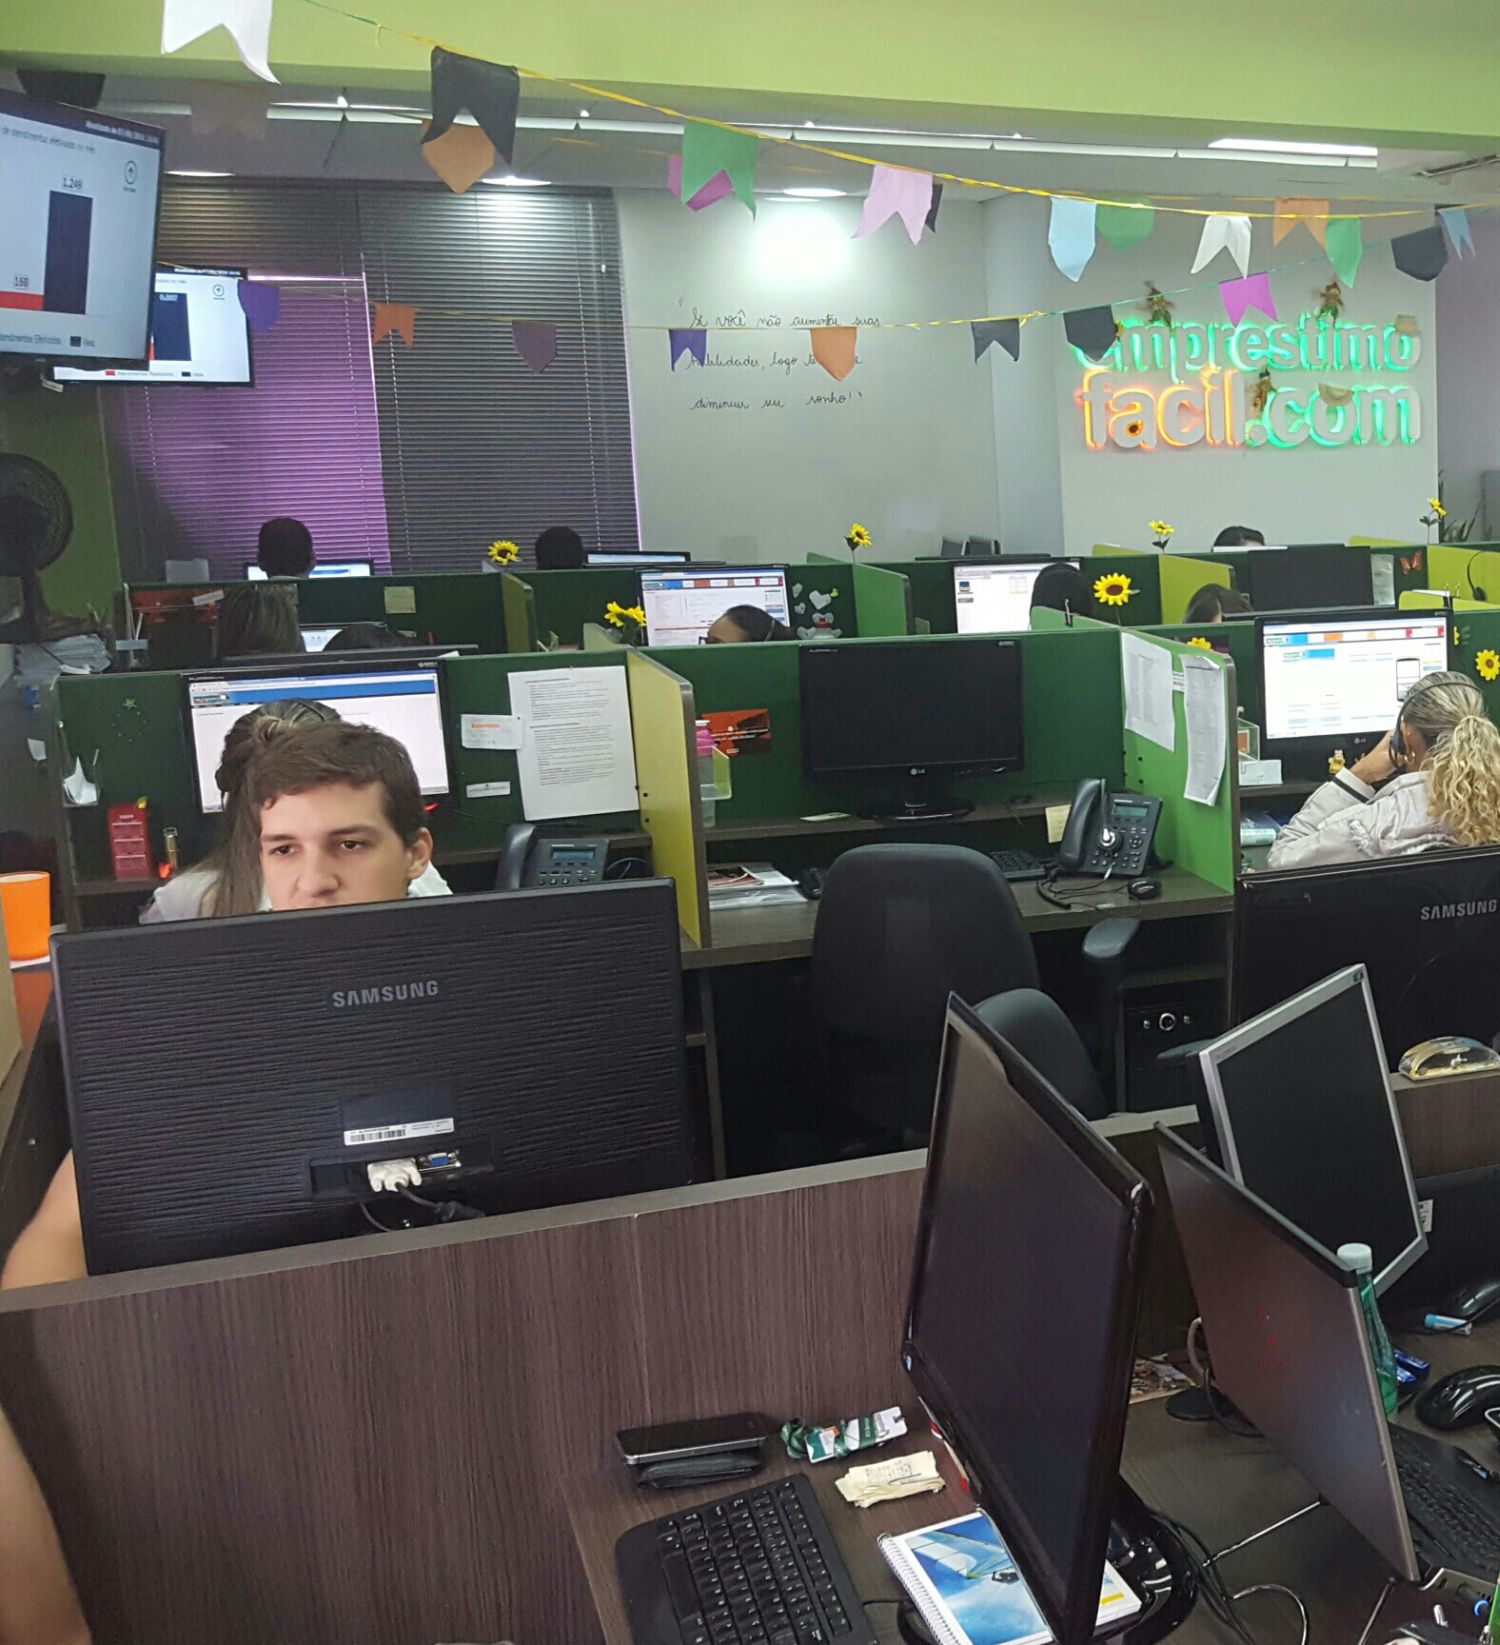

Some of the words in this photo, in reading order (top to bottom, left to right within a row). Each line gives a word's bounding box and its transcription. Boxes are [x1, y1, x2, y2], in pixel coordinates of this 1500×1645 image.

[716, 309, 746, 327] você
[756, 314, 782, 327] não
[851, 316, 880, 327] suas
[769, 352, 798, 376] logo
[1420, 899, 1497, 921] SAMSUNG
[332, 980, 440, 1008] SAMSUNG
